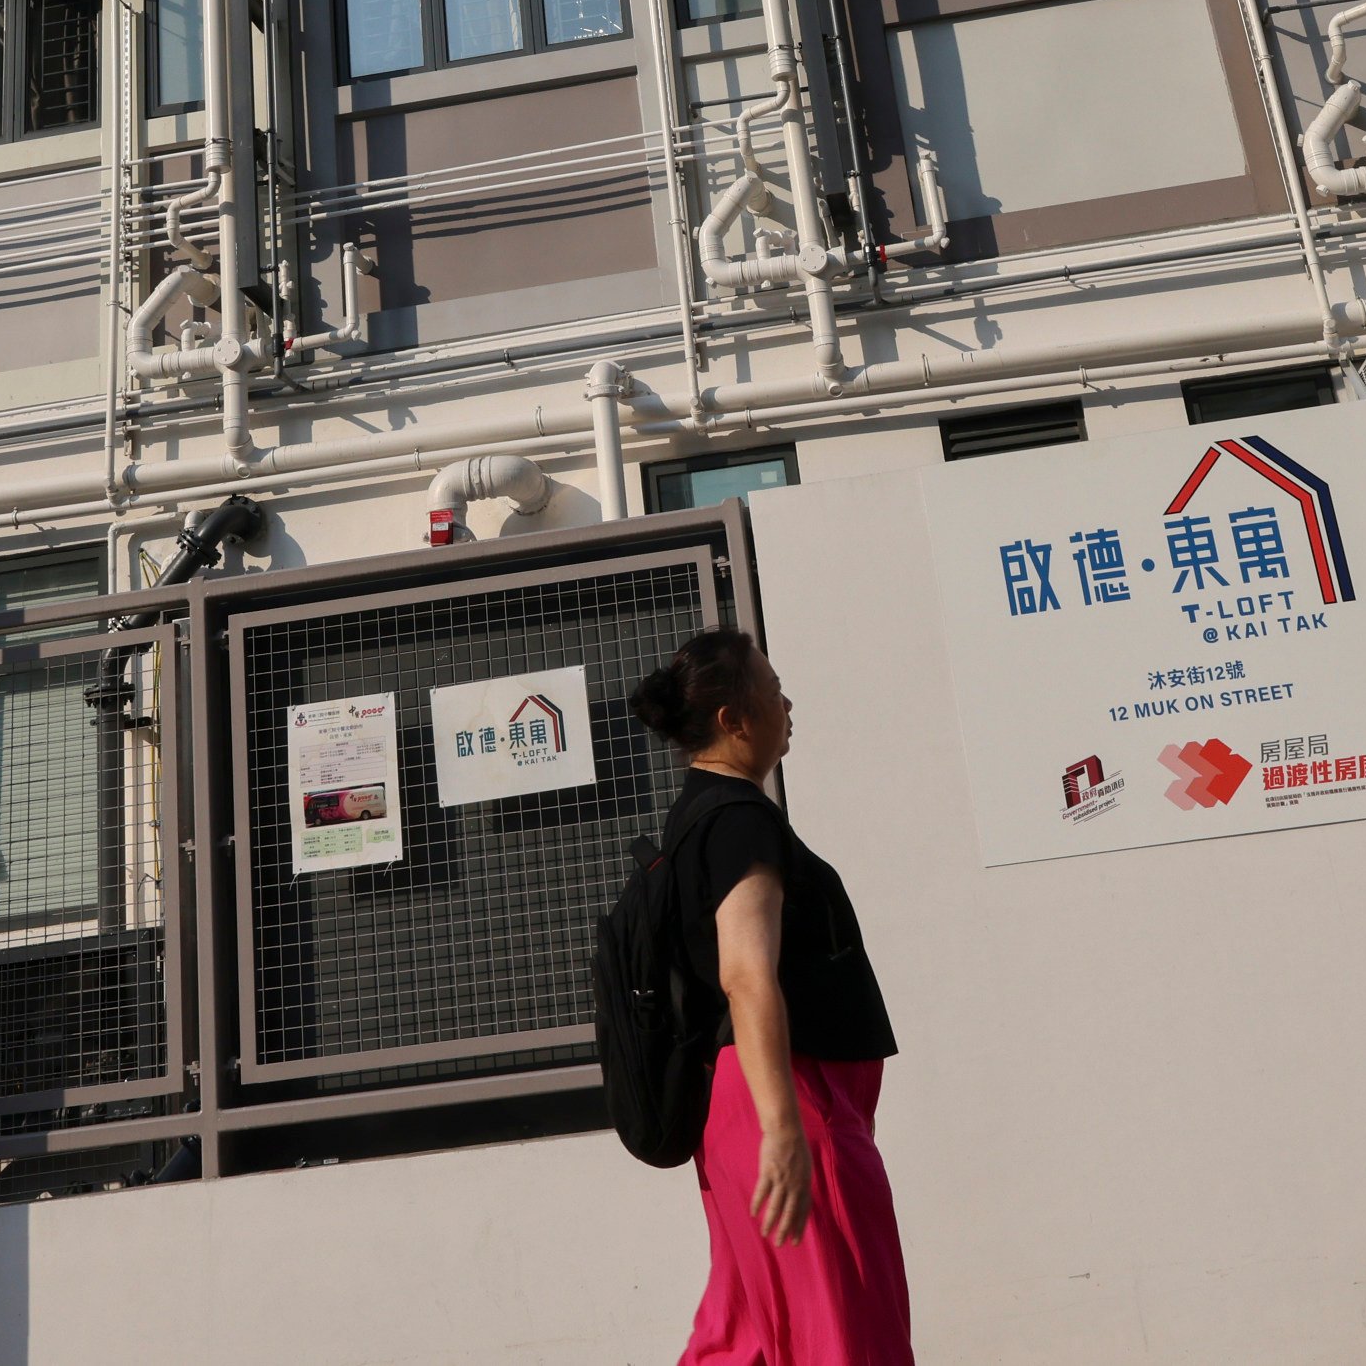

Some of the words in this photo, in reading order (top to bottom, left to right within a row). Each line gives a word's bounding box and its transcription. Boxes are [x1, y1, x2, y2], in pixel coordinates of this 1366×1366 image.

[1181, 591, 1294, 623] T-LOFT
[1226, 621, 1267, 641] KAI
[1277, 612, 1328, 633] TAK
[1147, 660, 1246, 691] 沐安街12號
[1109, 706, 1129, 721] 12
[1134, 699, 1180, 719] MUK
[1185, 694, 1214, 711] ON
[1221, 684, 1293, 706] STREET
[511, 748, 548, 760] T-LOFT
[1260, 734, 1329, 763] 房屋局
